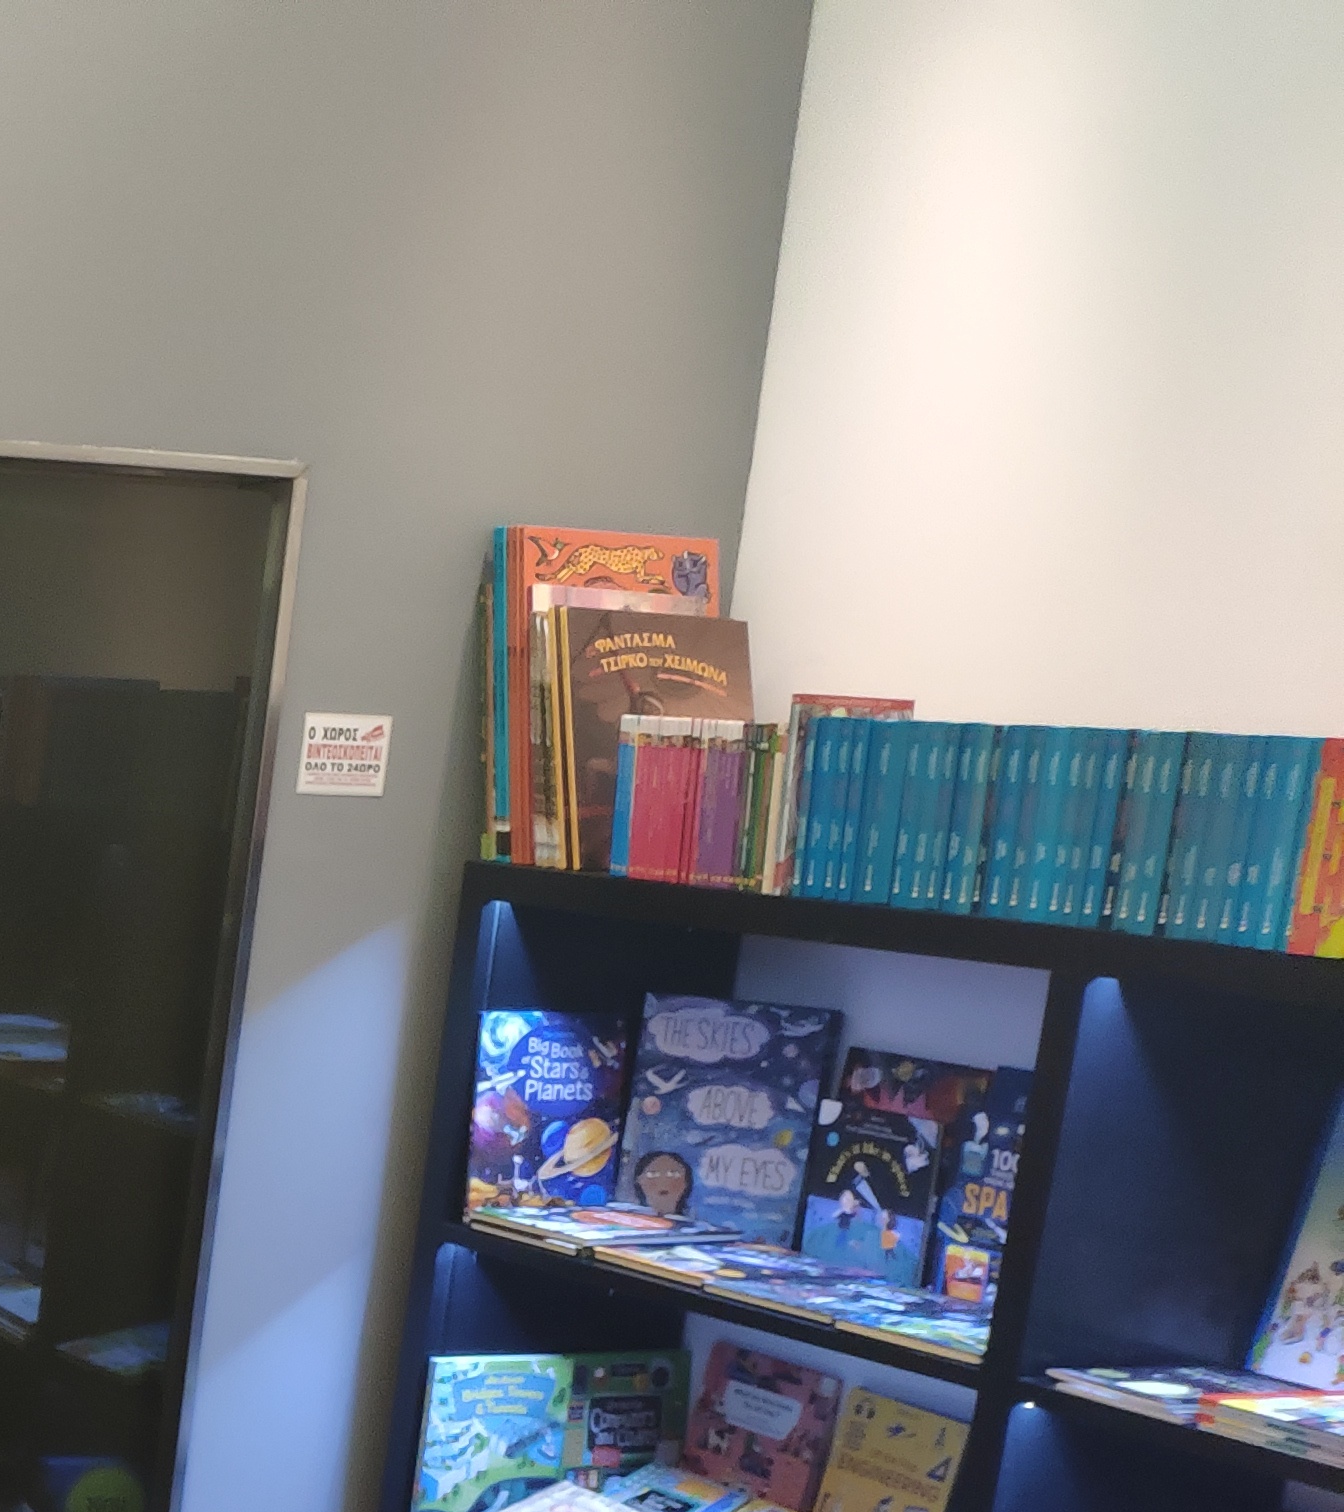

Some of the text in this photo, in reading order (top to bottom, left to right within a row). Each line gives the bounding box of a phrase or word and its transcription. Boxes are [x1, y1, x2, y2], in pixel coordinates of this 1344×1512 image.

[594, 632, 676, 653] ΦΑΝΤΑΣΜΑ
[600, 652, 649, 673] ΤΣΙΡΚΟ
[663, 653, 728, 687] ΧΕΙΜΩΝΑ
[308, 726, 359, 742] Ο ΧΩΡΟΣ
[305, 761, 381, 774] ΟΛΟ ΤΟ 24ΩΡΟ
[662, 1016, 755, 1055] THE SKIES
[528, 1037, 584, 1059] Big Book
[529, 1055, 580, 1079] Stars
[525, 1079, 593, 1101] Planets
[700, 1089, 758, 1125] ABOVE
[707, 1154, 787, 1190] MY EYES
[962, 1182, 1009, 1222] SPA
